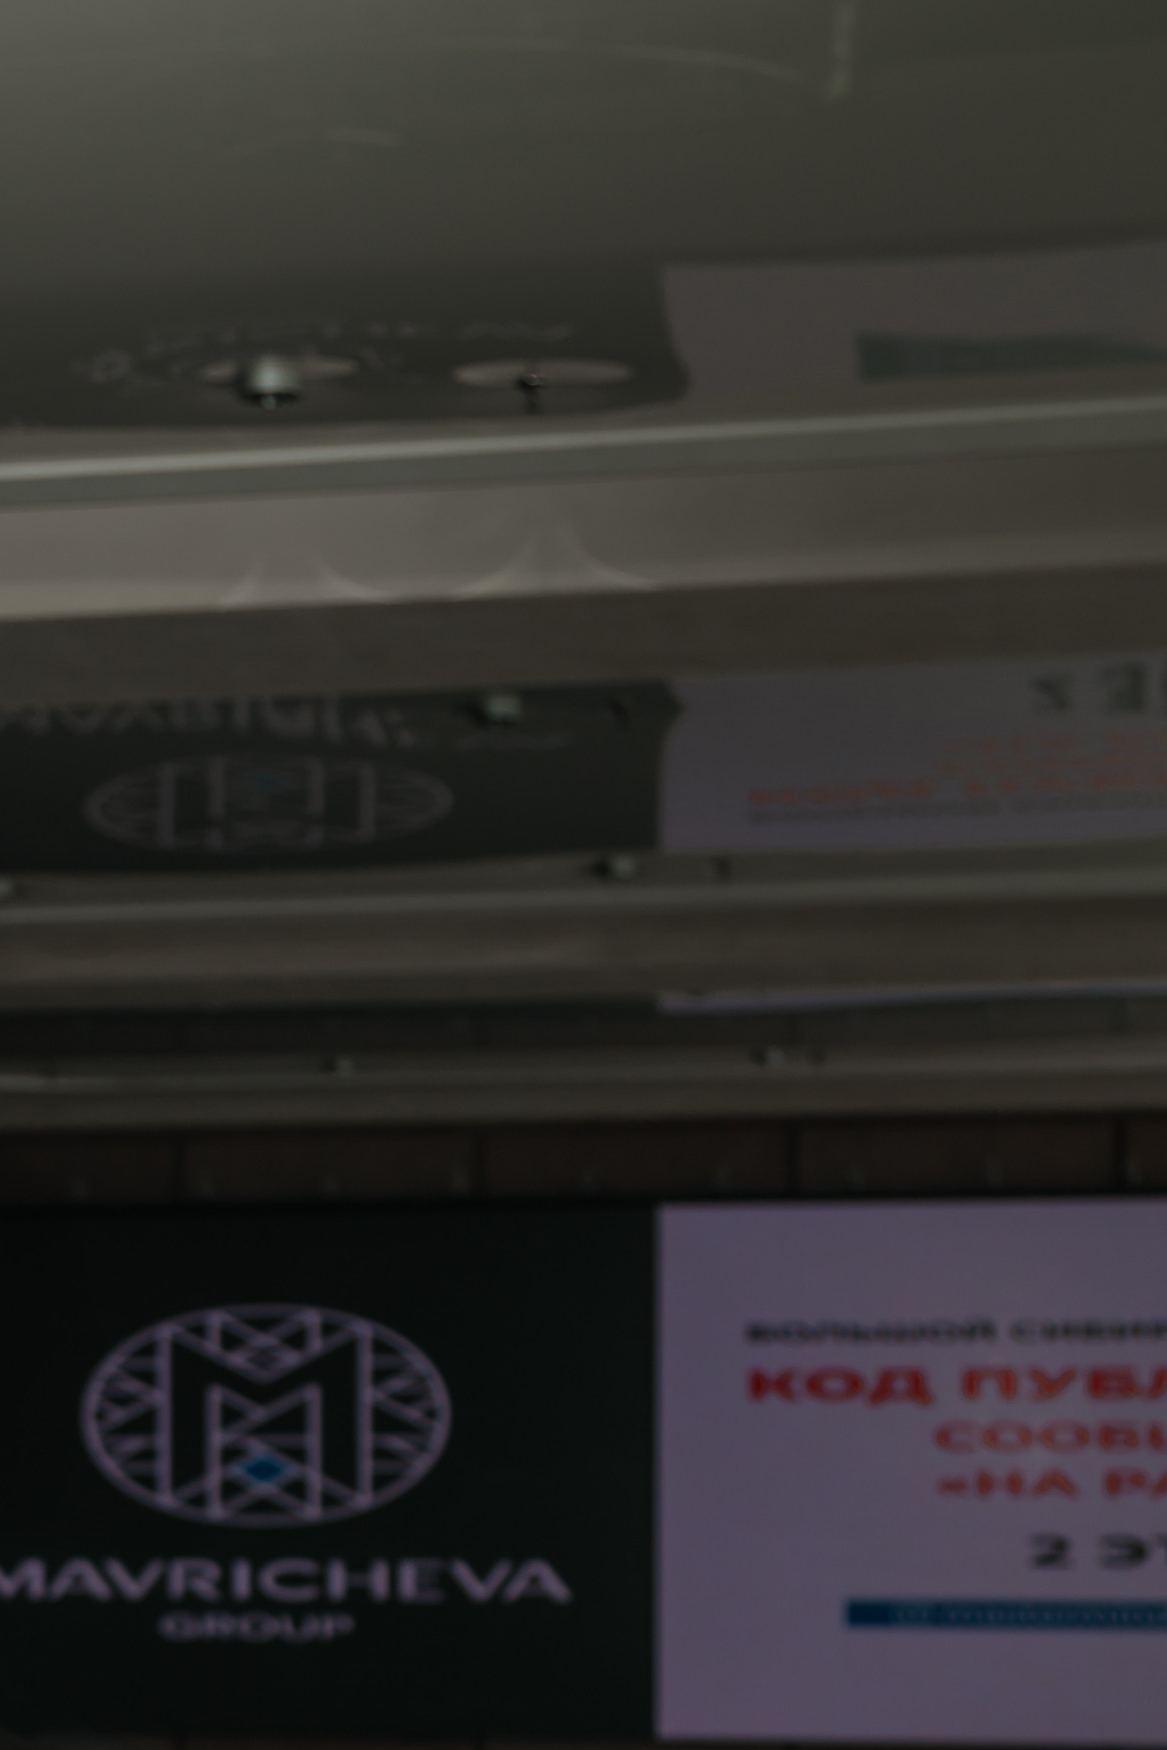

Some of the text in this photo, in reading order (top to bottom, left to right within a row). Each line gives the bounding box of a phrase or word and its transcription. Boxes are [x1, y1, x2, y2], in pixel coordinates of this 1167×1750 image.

[747, 1366, 933, 1408] КОД
[1027, 1532, 1075, 1569] 2
[159, 1610, 356, 1642] GROUP
